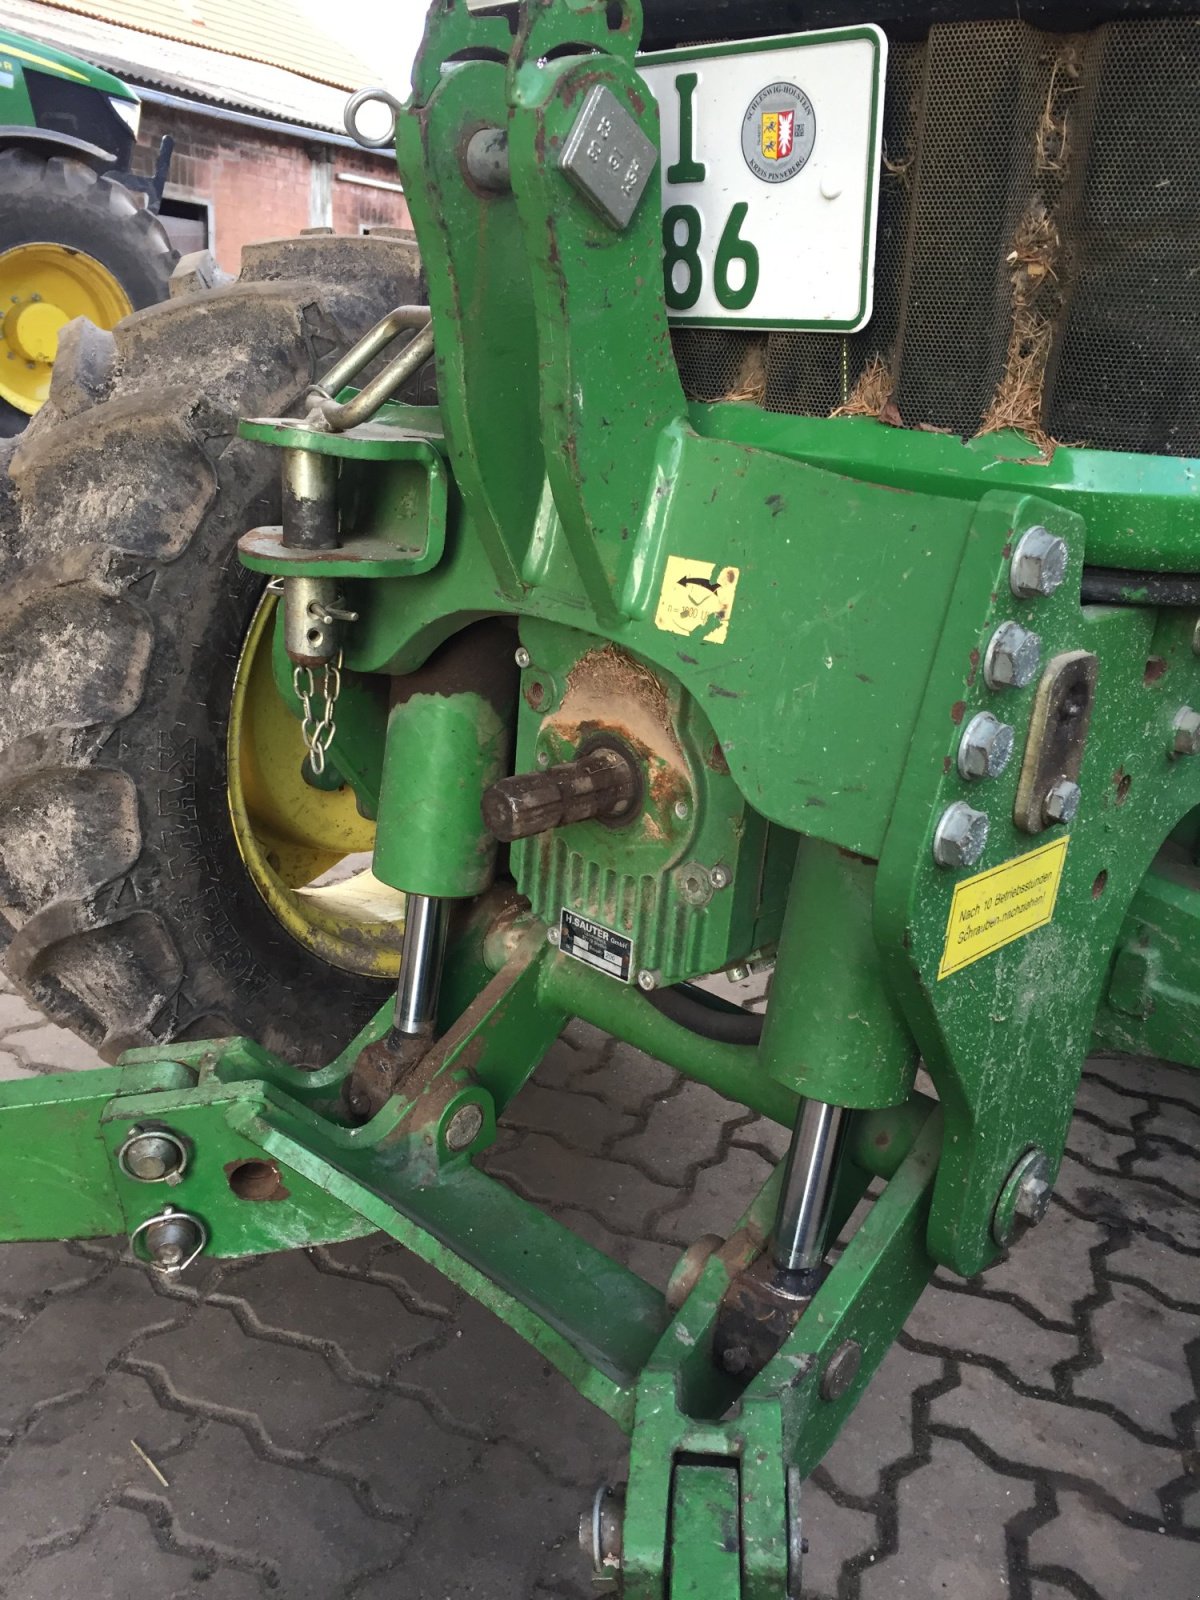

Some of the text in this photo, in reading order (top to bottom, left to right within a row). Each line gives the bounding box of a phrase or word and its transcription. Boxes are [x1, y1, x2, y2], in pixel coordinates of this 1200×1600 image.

[747, 84, 812, 121] SCHLESWIG-HOLSTEIN
[668, 72, 706, 184] I
[749, 156, 806, 180] KREIS PINNEBERG
[662, 202, 760, 311] 86
[959, 872, 1052, 922] Nach 10 Betriebsstunden
